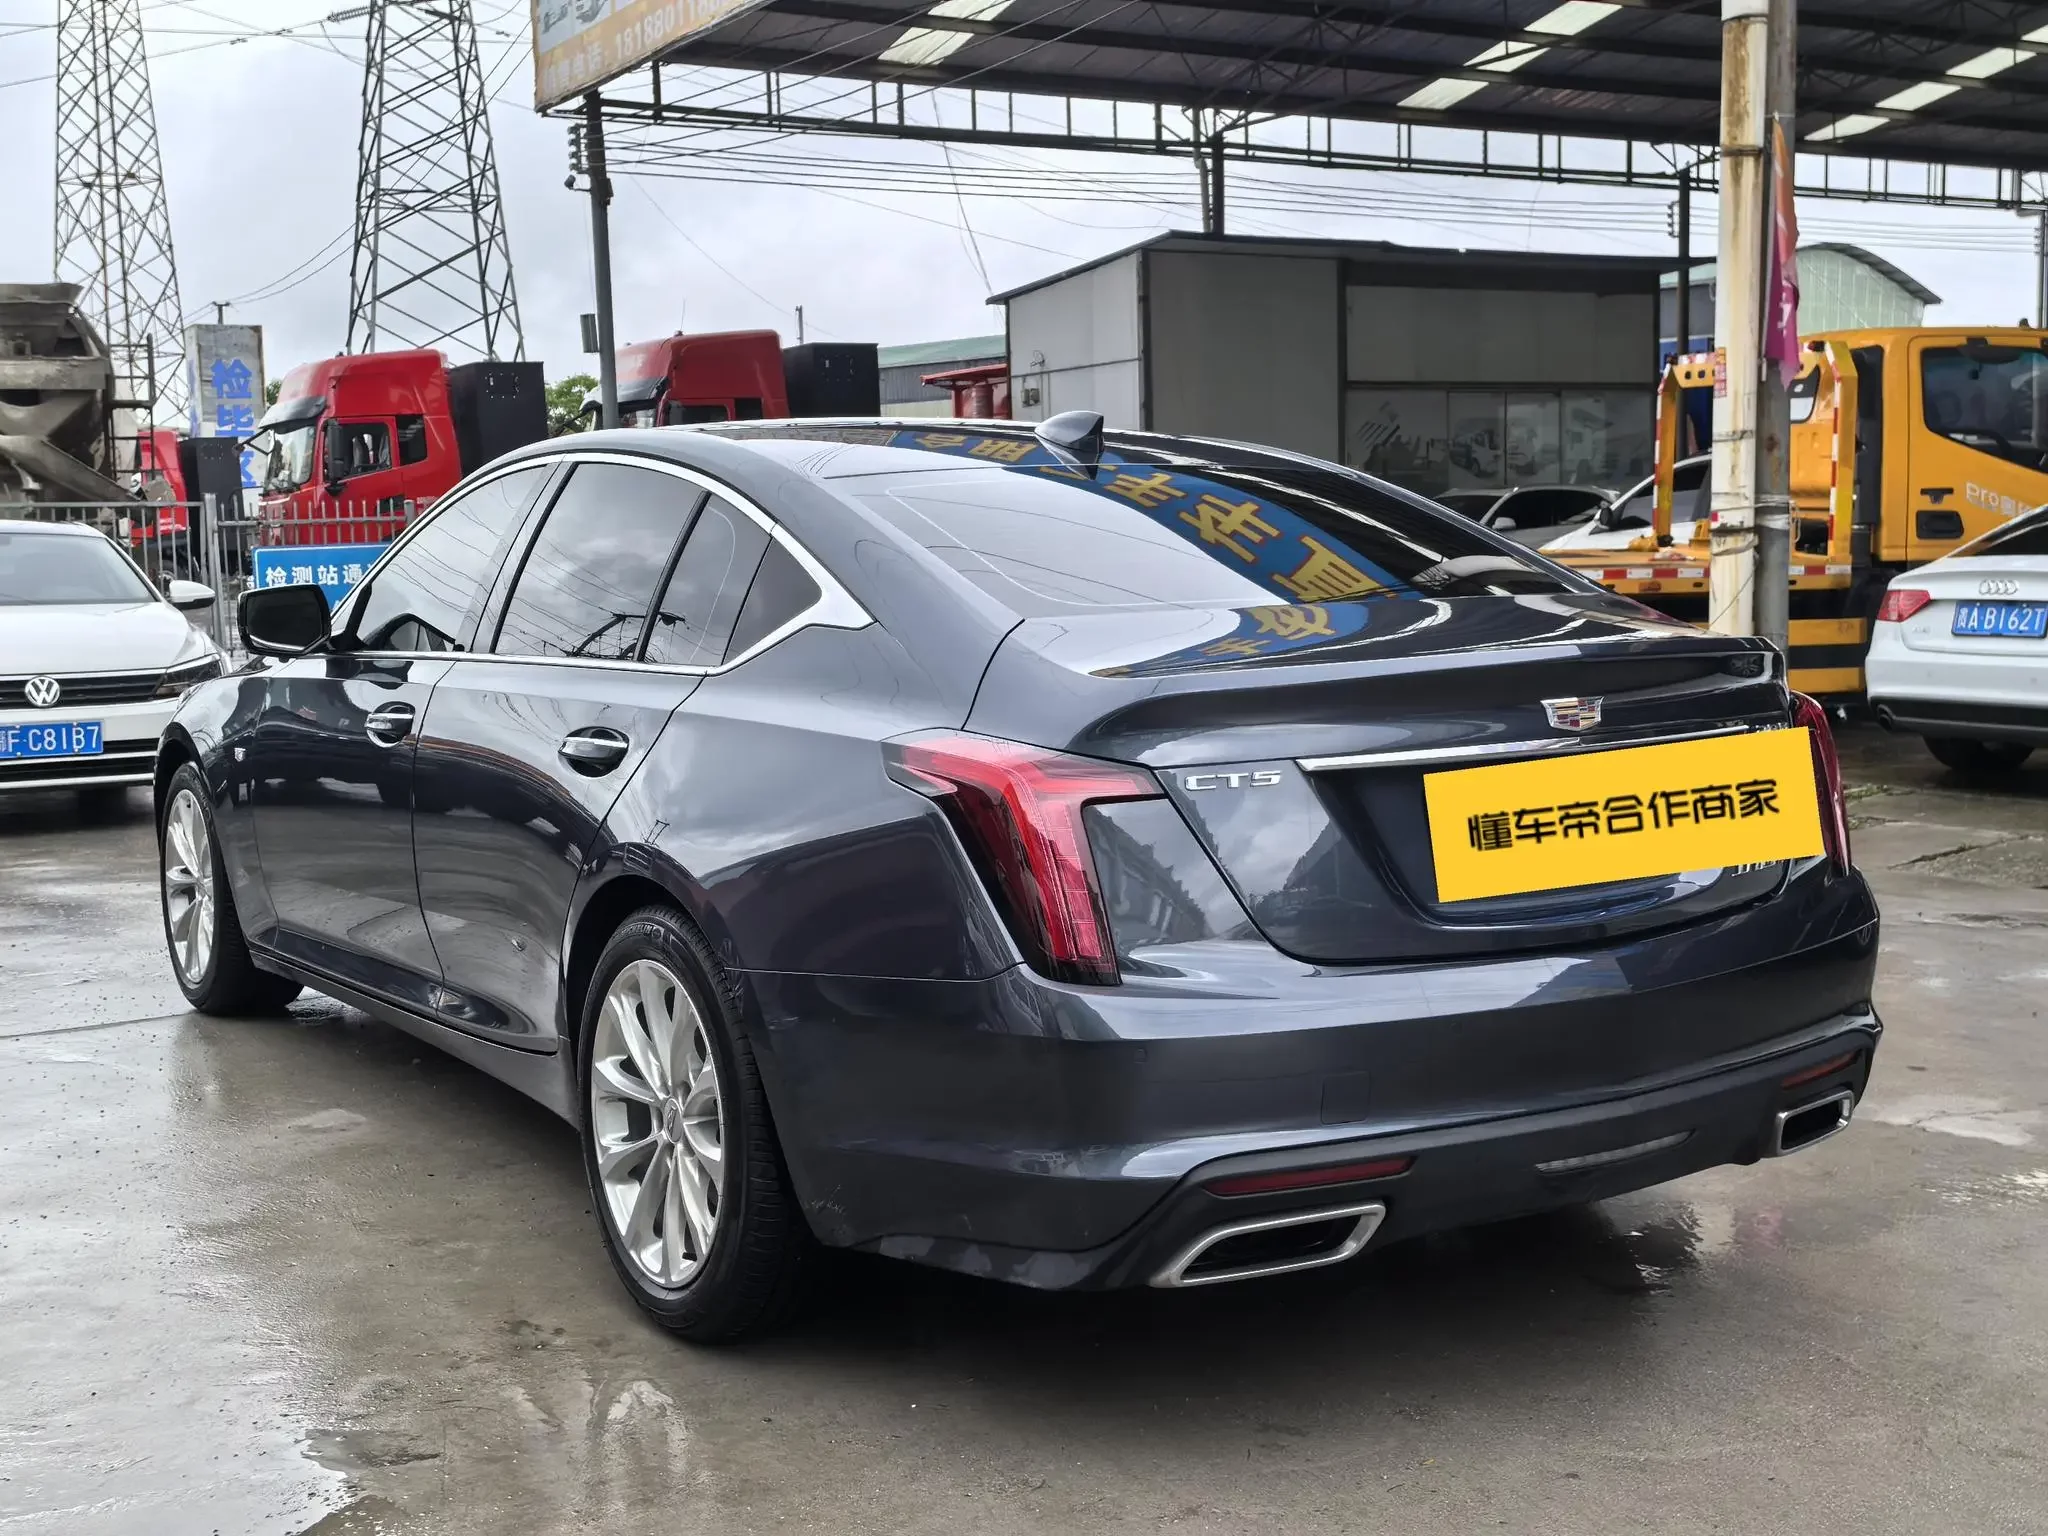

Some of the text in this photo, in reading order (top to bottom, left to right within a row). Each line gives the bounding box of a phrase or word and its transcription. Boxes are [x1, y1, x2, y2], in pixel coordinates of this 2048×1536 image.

[265, 563, 373, 588] 检测站通
[1185, 770, 1281, 791] CT5
